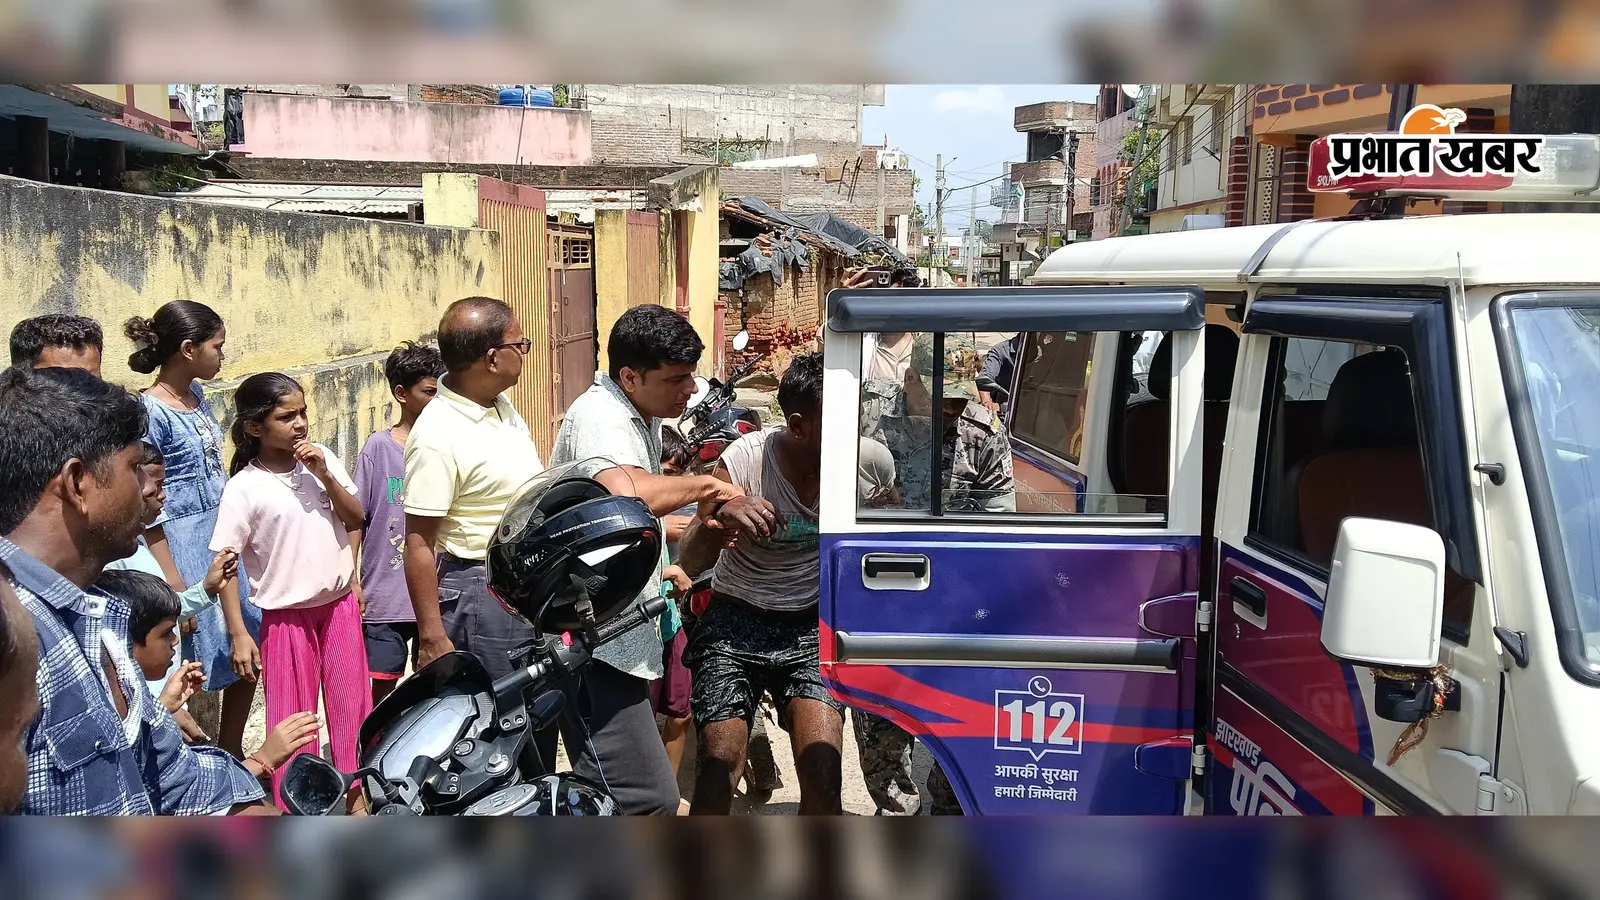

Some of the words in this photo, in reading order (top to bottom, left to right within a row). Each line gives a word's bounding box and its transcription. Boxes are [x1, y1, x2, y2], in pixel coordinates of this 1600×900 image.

[1003, 699, 1076, 746] 112
[1215, 717, 1262, 767] झारखण्ड
[994, 763, 1039, 780] आपकी
[1041, 767, 1079, 785] सुरक्षा
[994, 784, 1026, 799] हमारी
[1028, 784, 1078, 802] जिम्मेदारी
